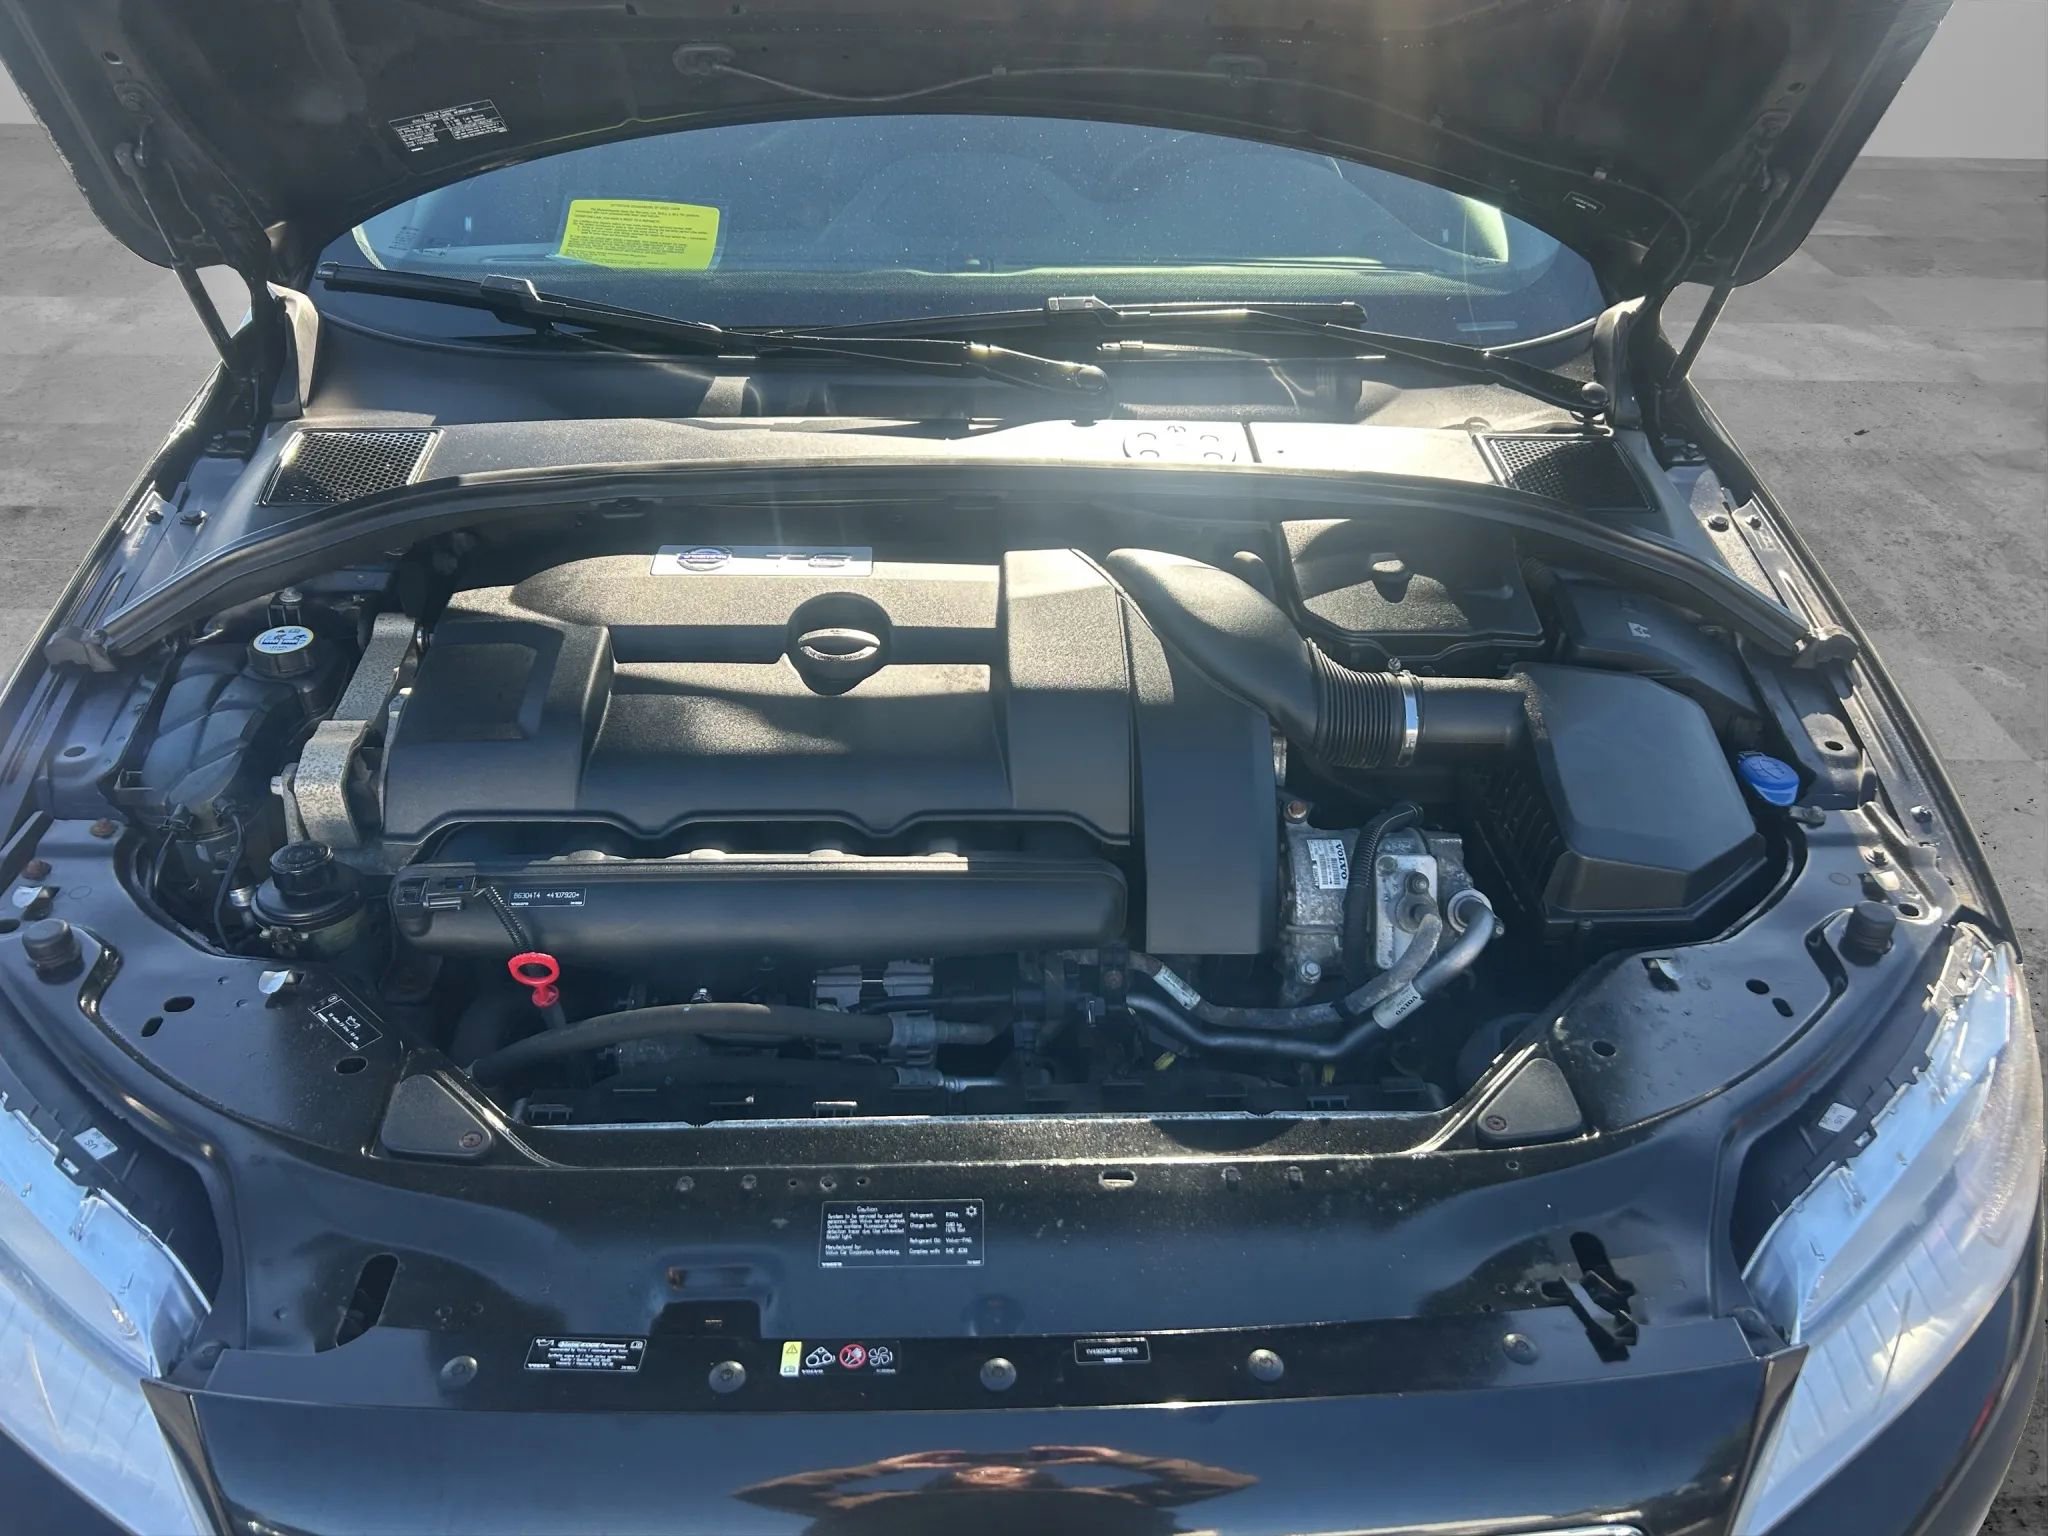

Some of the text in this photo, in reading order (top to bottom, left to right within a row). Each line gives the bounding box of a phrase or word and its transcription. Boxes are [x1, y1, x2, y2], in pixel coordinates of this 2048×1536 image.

[1336, 844, 1348, 880] VOLVO
[1395, 995, 1418, 1016] VOLVO
[856, 1205, 878, 1213] Caution
